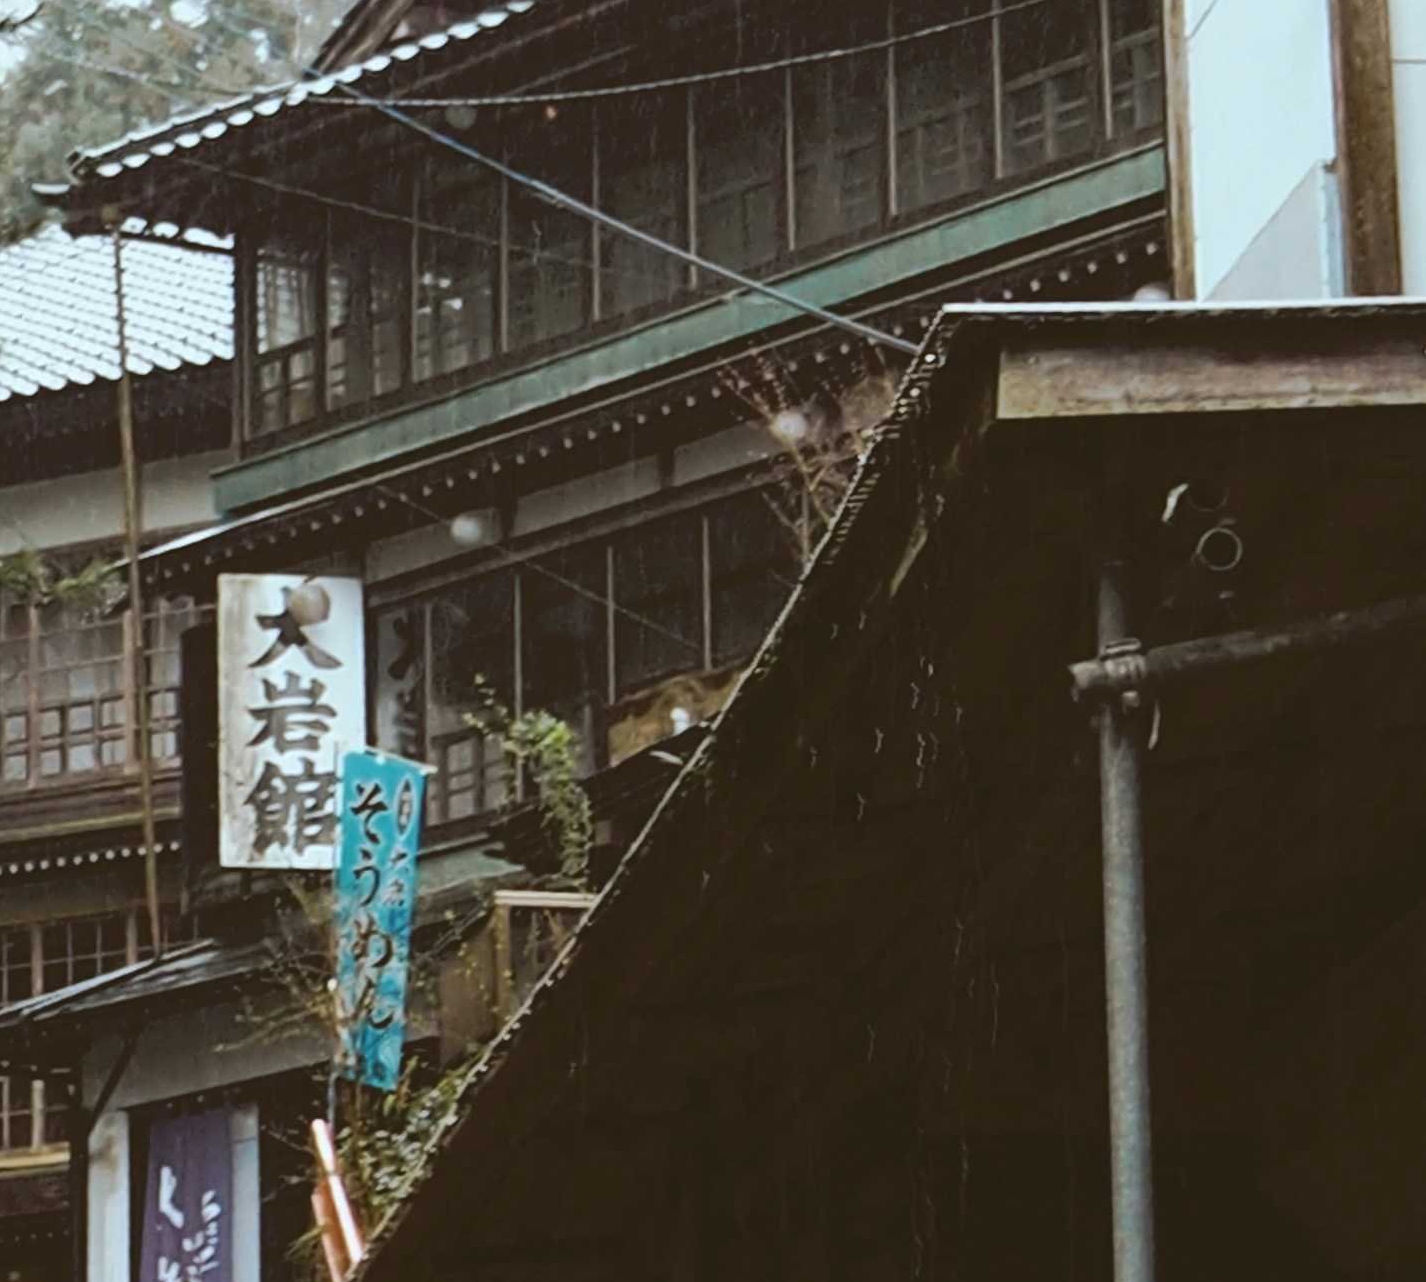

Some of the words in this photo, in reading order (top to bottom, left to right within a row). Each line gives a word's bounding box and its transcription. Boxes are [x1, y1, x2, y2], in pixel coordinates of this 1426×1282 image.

[243, 586, 343, 857] 大岩館
[349, 781, 394, 1029] そうめん
